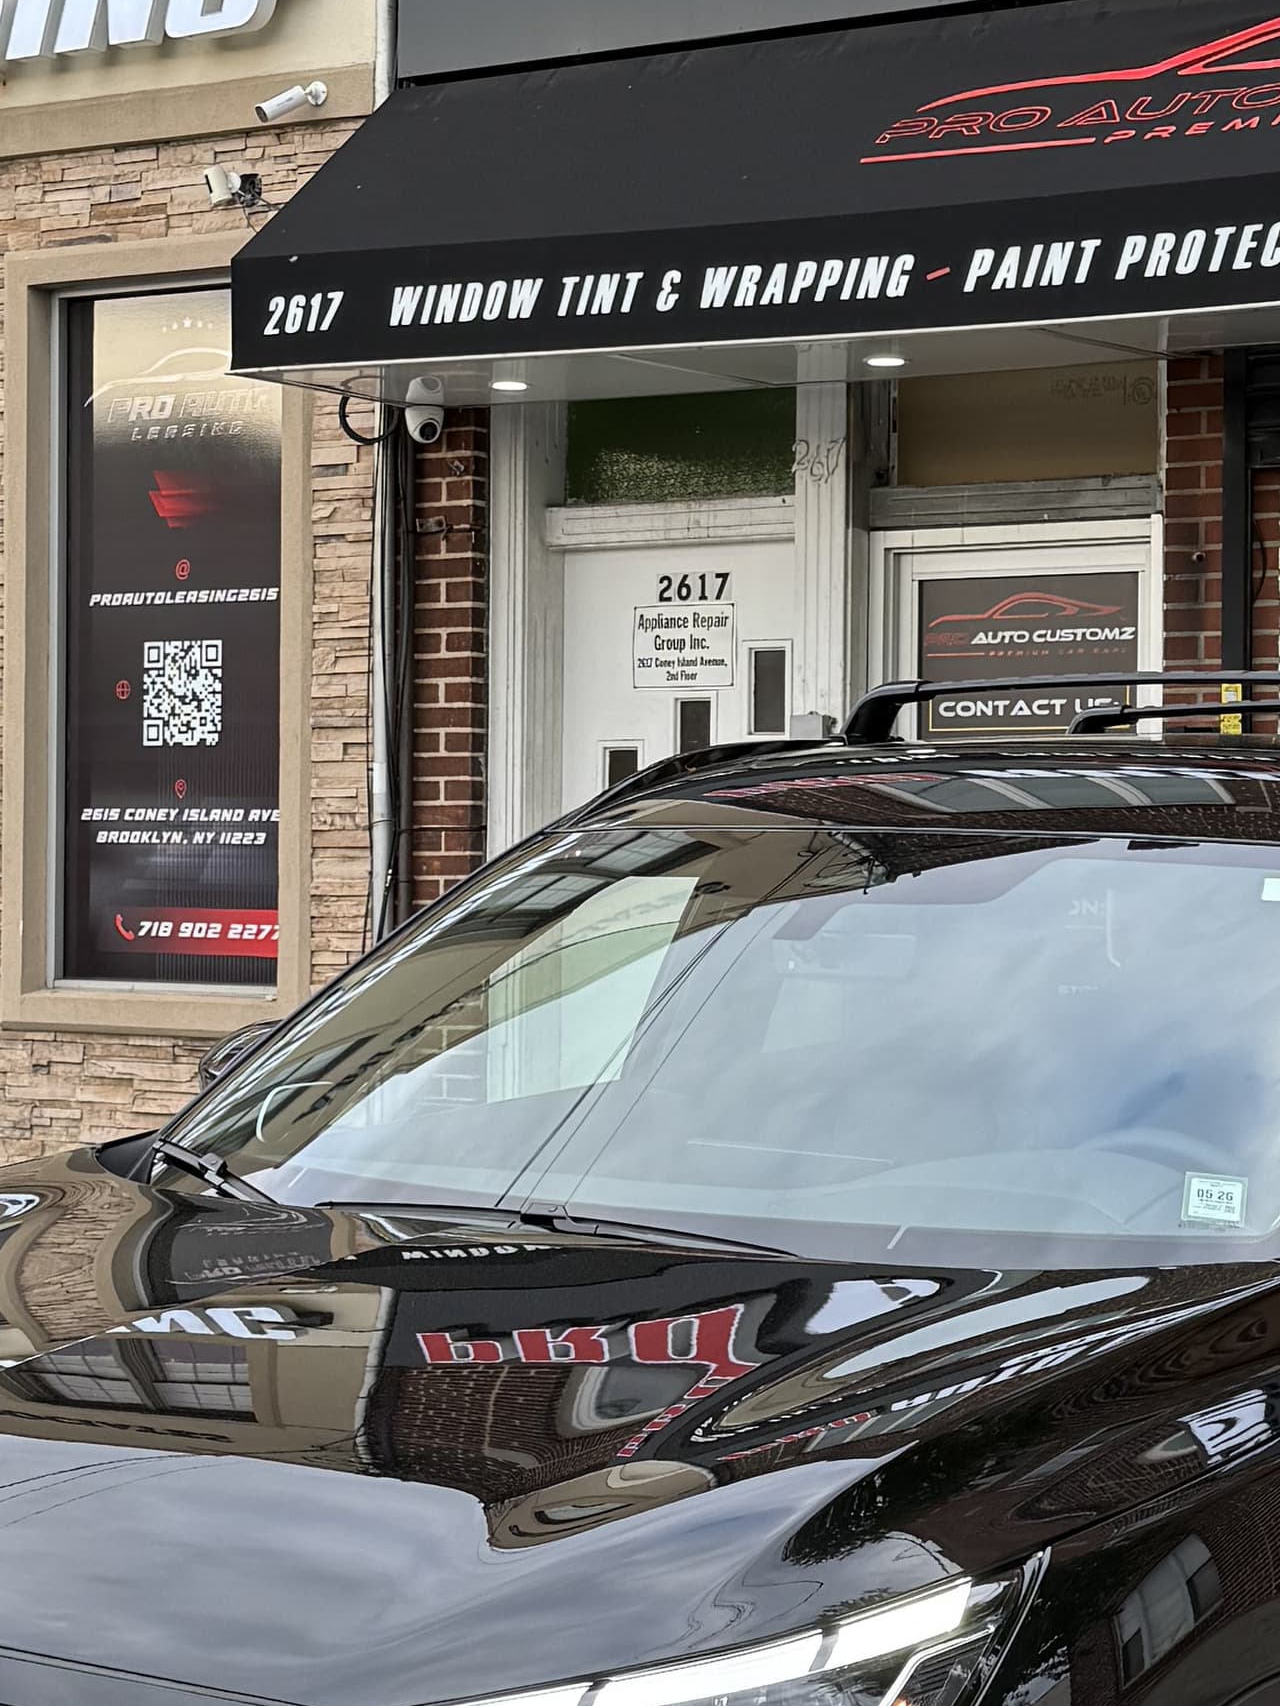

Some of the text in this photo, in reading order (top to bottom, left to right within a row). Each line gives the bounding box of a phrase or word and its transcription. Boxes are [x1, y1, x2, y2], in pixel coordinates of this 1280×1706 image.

[876, 104, 1052, 144] PRO
[264, 290, 344, 336] 2617
[389, 278, 540, 327] WINDOW
[555, 271, 644, 316] TINT
[657, 268, 683, 312] &
[698, 253, 916, 309] WRAPPING
[963, 239, 1101, 292] PAINT
[107, 394, 176, 422] PRO
[131, 421, 244, 442] LEASING
[89, 587, 280, 607] PROAUTOLEASING2615
[658, 572, 730, 602] 2617
[638, 611, 730, 633] Appliance Repair
[654, 633, 710, 654] Group Inc.
[971, 630, 1030, 645] AUTO
[1032, 626, 1136, 644] CUSTOMZ
[938, 698, 1067, 718] CONTACT
[81, 808, 121, 821] 2615
[124, 808, 179, 821] CONEY
[182, 809, 244, 822] ISLAND
[96, 831, 188, 845] BROOKLYN,
[193, 831, 216, 844] NY
[138, 921, 173, 937] 718
[178, 922, 223, 938] 902
